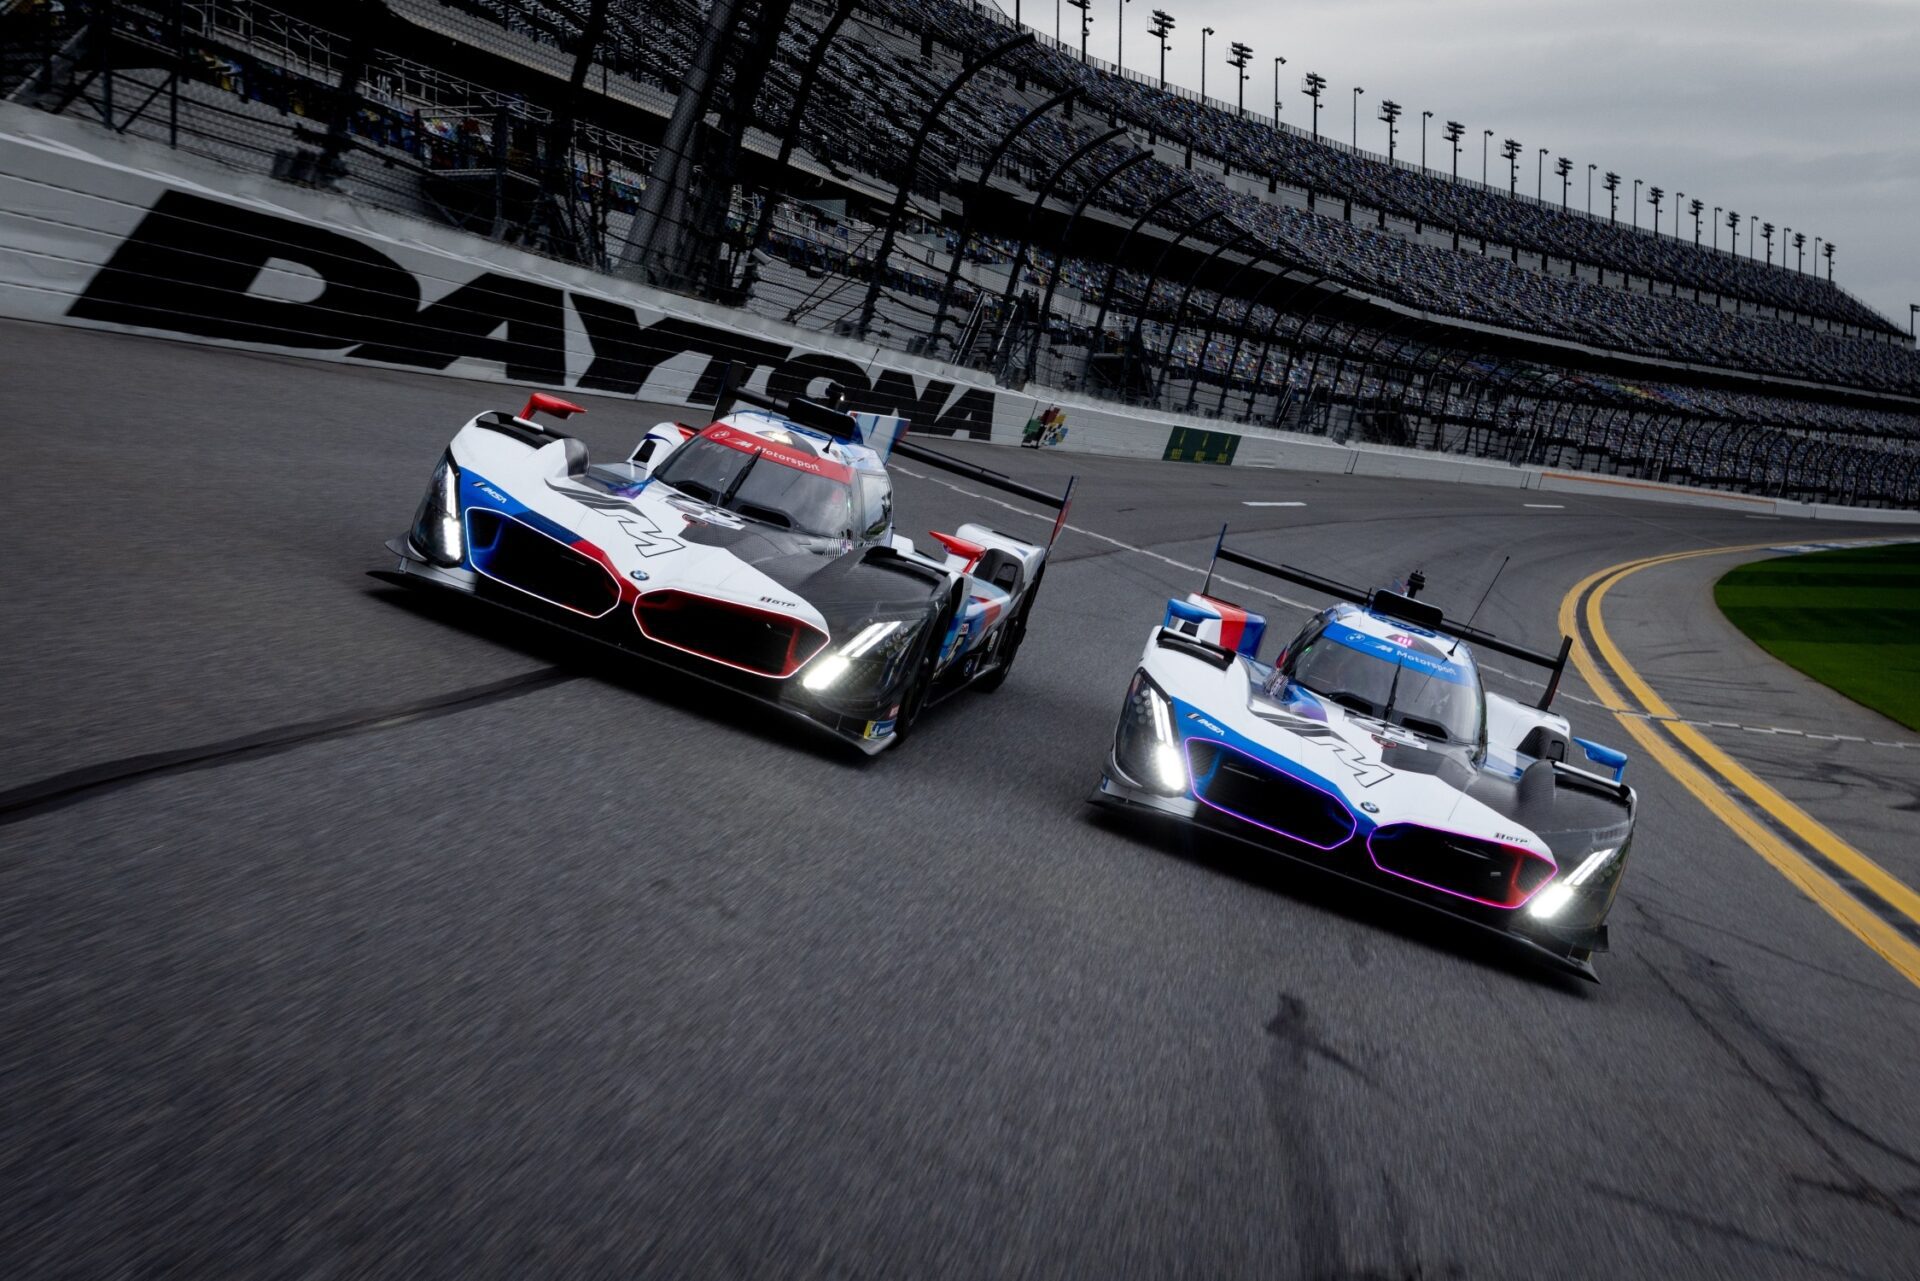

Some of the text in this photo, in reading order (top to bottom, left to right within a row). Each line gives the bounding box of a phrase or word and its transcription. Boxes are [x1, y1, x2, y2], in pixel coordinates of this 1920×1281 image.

[65, 189, 996, 441] DAYTONA
[754, 445, 820, 471] Motorsport
[1396, 650, 1457, 675] Motorsport
